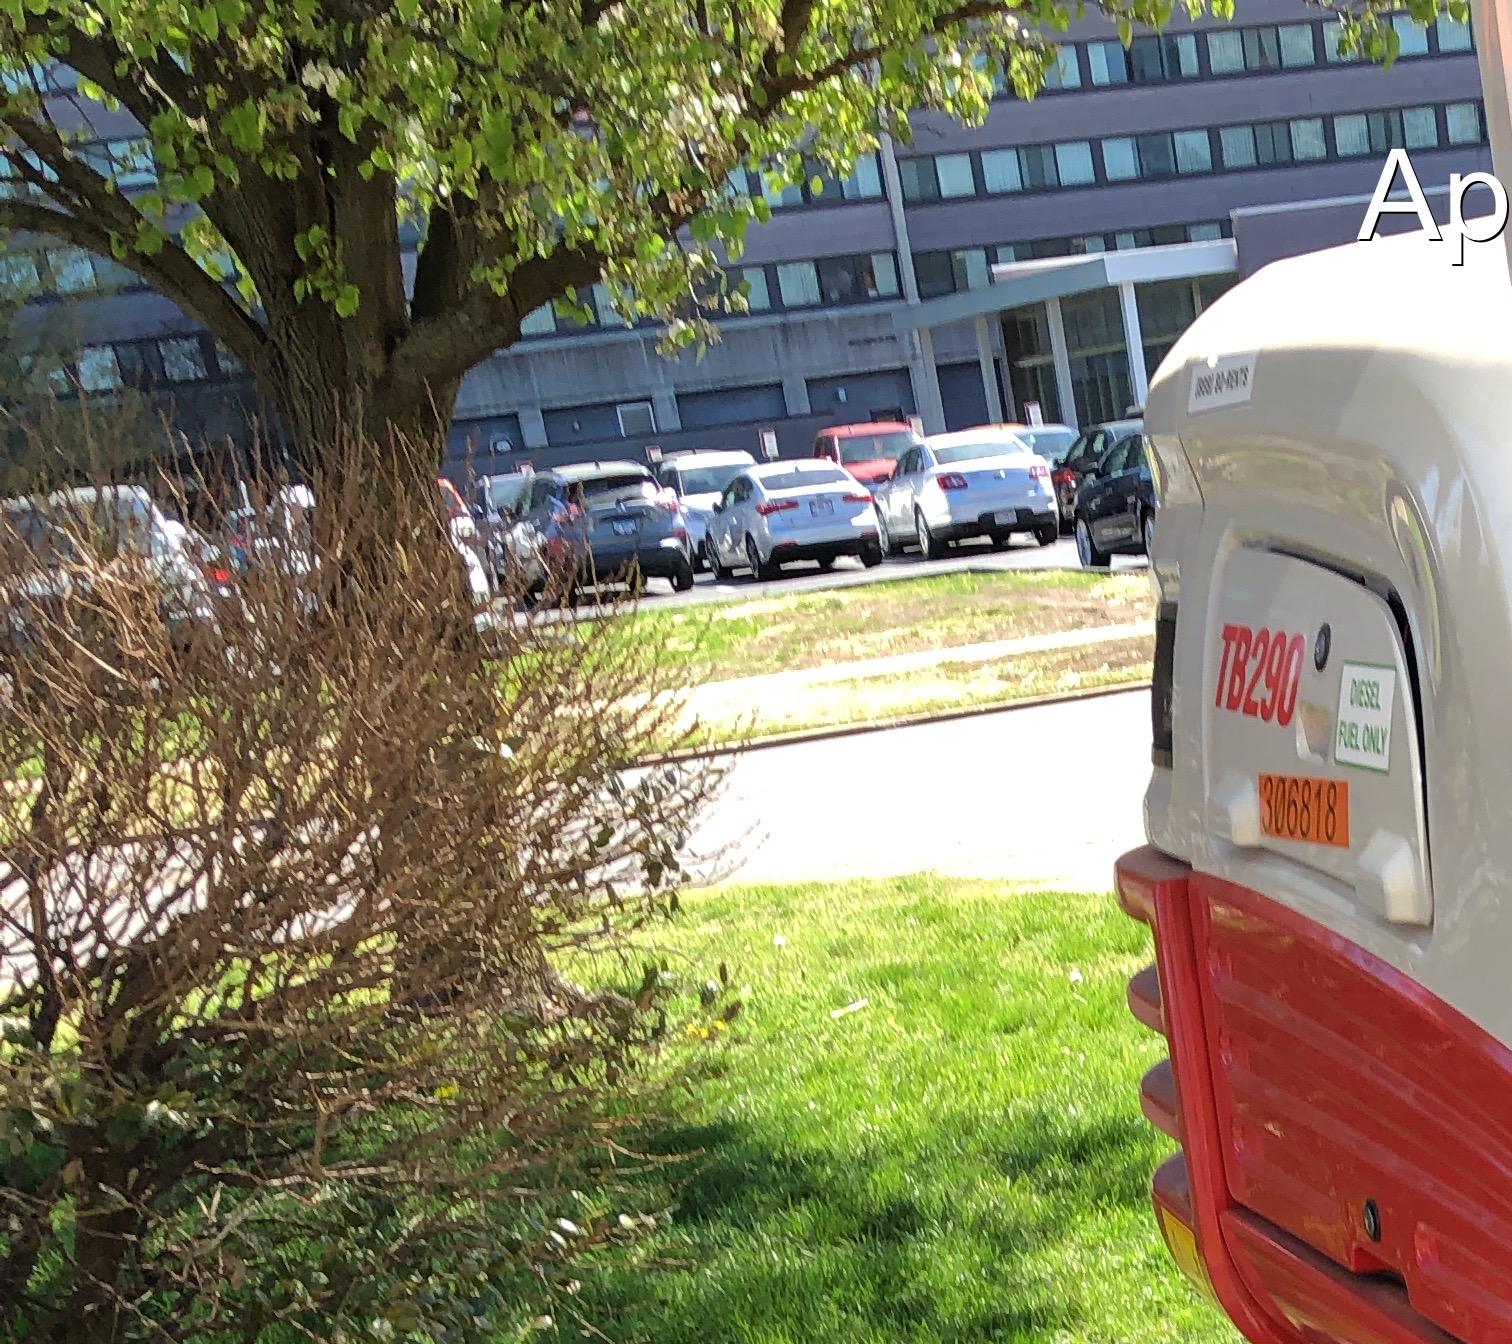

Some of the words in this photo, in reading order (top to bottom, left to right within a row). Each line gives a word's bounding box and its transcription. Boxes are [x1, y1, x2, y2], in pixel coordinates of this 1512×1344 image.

[1215, 622, 1306, 727] TB290
[1349, 677, 1382, 711] DIESEL
[1338, 719, 1361, 753] FUEL
[1362, 722, 1388, 757] ONLY
[1260, 774, 1338, 842] 306818
